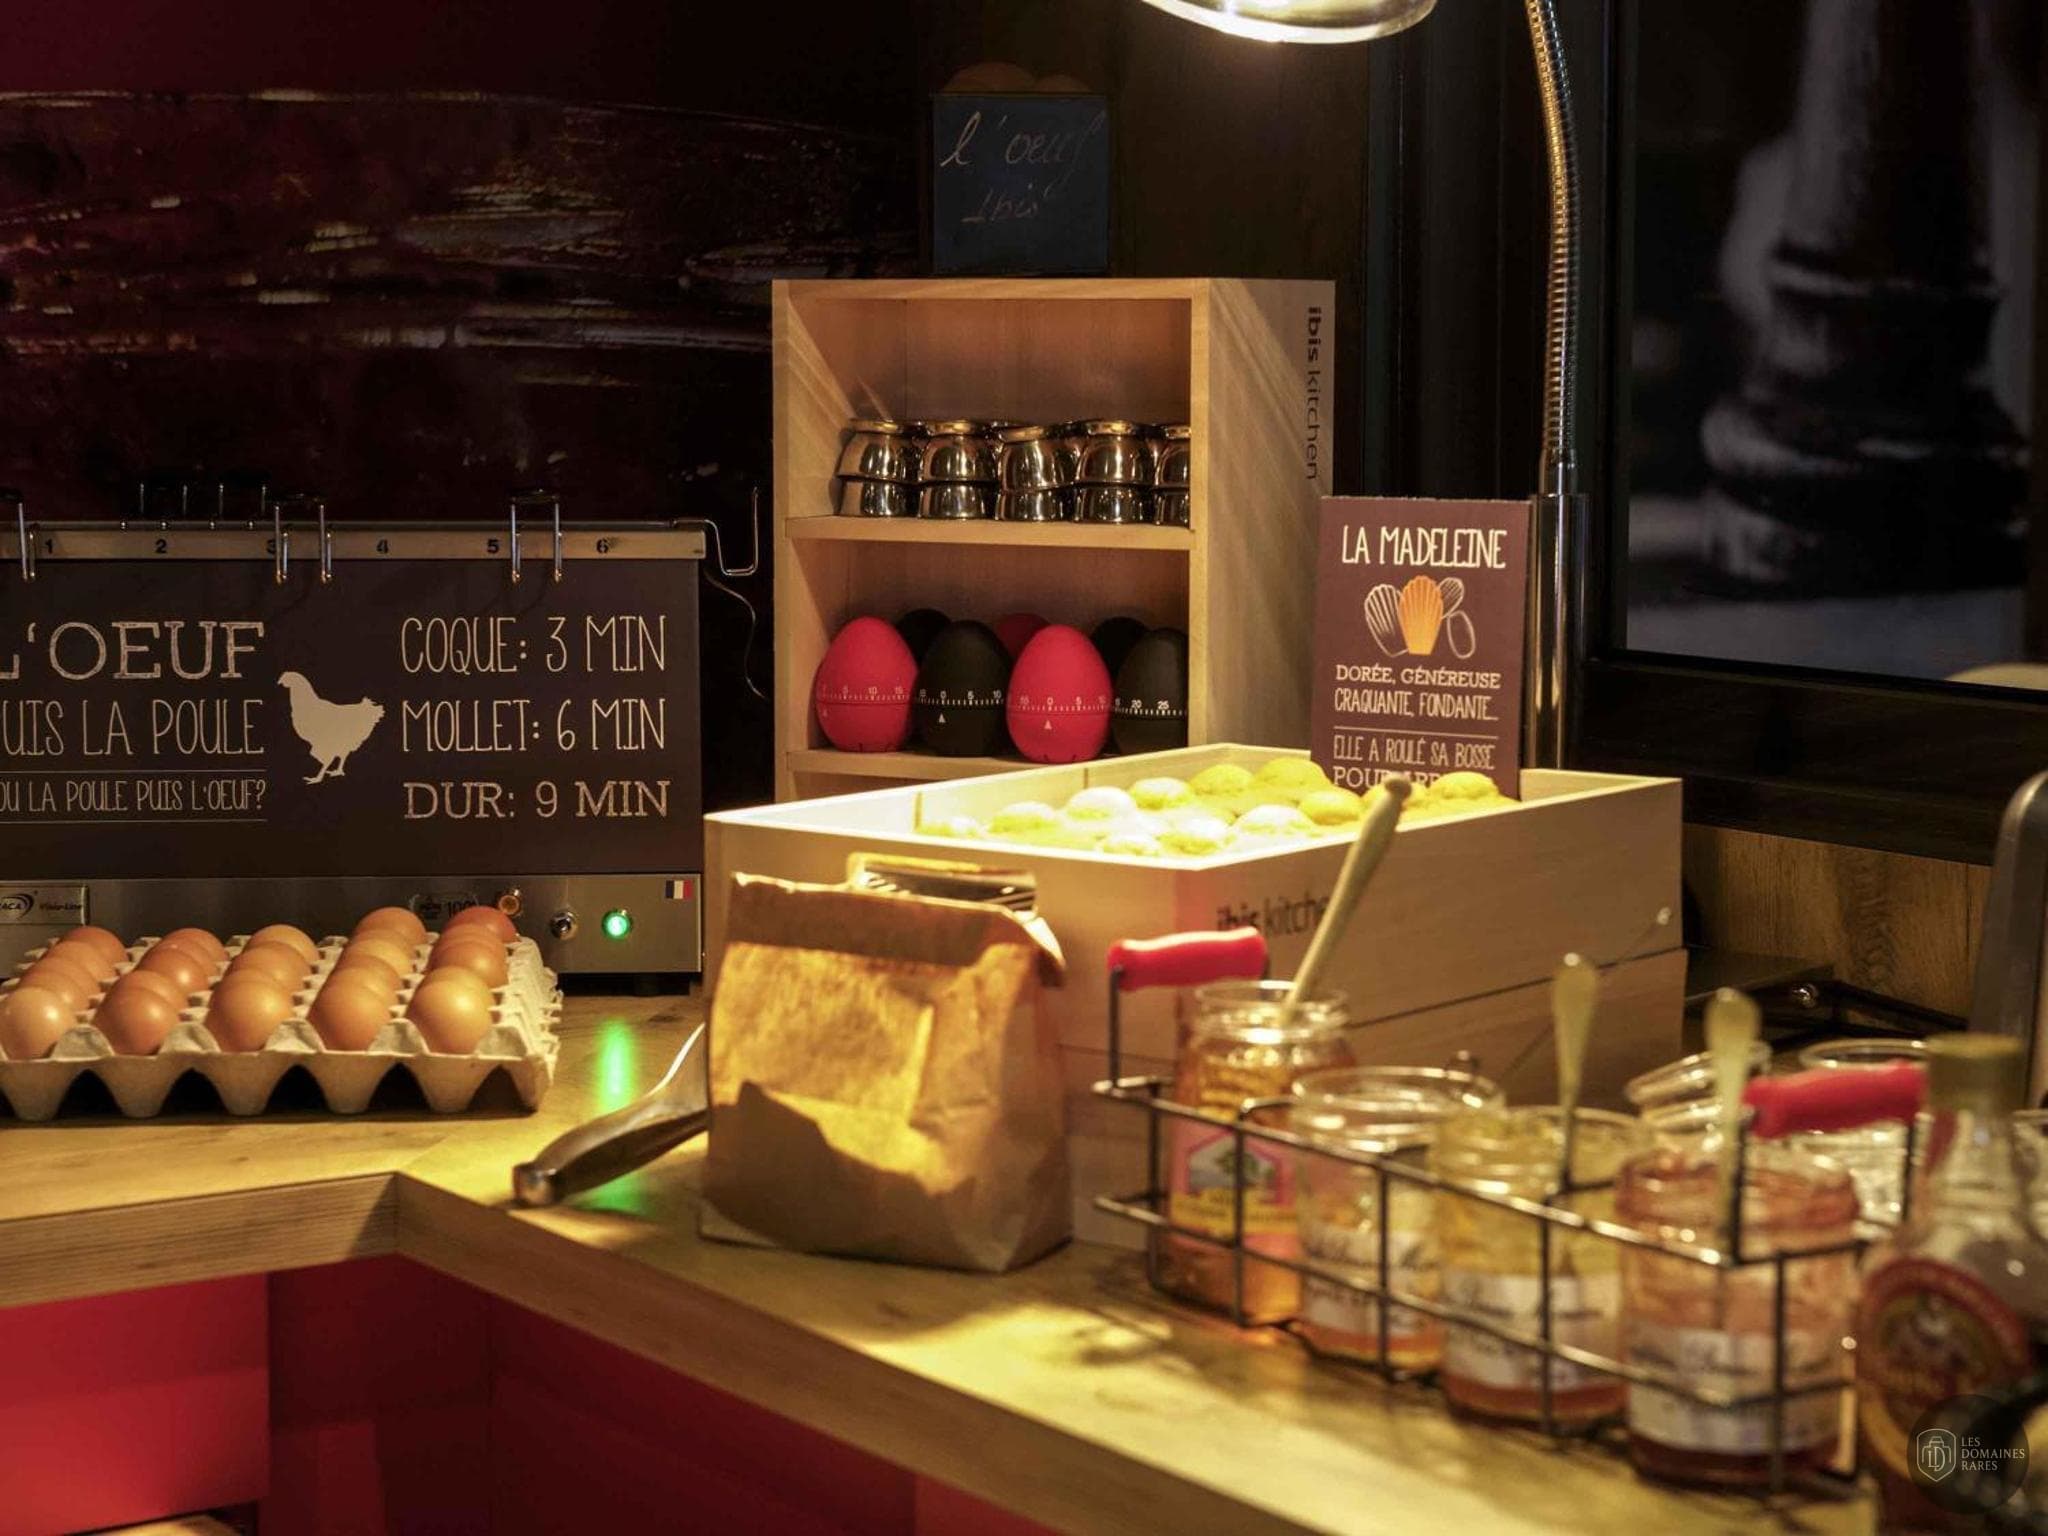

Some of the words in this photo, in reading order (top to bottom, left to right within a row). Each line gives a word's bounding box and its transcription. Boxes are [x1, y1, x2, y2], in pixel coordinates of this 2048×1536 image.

[1307, 306, 1322, 363] ibis
[1306, 370, 1321, 480] kitchen
[44, 538, 54, 555] 1
[155, 538, 168, 554] 2
[375, 538, 389, 555] 4
[487, 538, 500, 555] 5
[596, 538, 609, 555] 6
[1341, 525, 1371, 564] LA
[1379, 526, 1508, 569] MADELEINE
[401, 616, 527, 675] COQUE:
[546, 616, 568, 673] 3
[586, 615, 667, 673] MIN
[1335, 663, 1396, 685] DORÉE,
[1400, 665, 1502, 690] GÉNÉREUSE
[1131, 699, 1143, 709] 20
[1334, 687, 1415, 718] CRAQUANTE,
[82, 698, 134, 756] LA
[152, 698, 264, 755] POULE
[402, 699, 540, 752] MOLLET:
[556, 698, 577, 752] 6
[591, 698, 667, 750] MIN
[1333, 734, 1365, 762] ELLE
[1368, 737, 1381, 763] A
[1385, 736, 1427, 766] ROULÉ
[1430, 741, 1450, 767] SA
[1455, 742, 1497, 771] BOSSE
[29, 780, 57, 812] LA
[66, 780, 129, 812] POULE
[136, 779, 184, 811] PUIS
[191, 779, 267, 811] L'OEUF?
[403, 780, 516, 819] DUR:
[535, 780, 559, 818] 9
[574, 779, 671, 818] MIN
